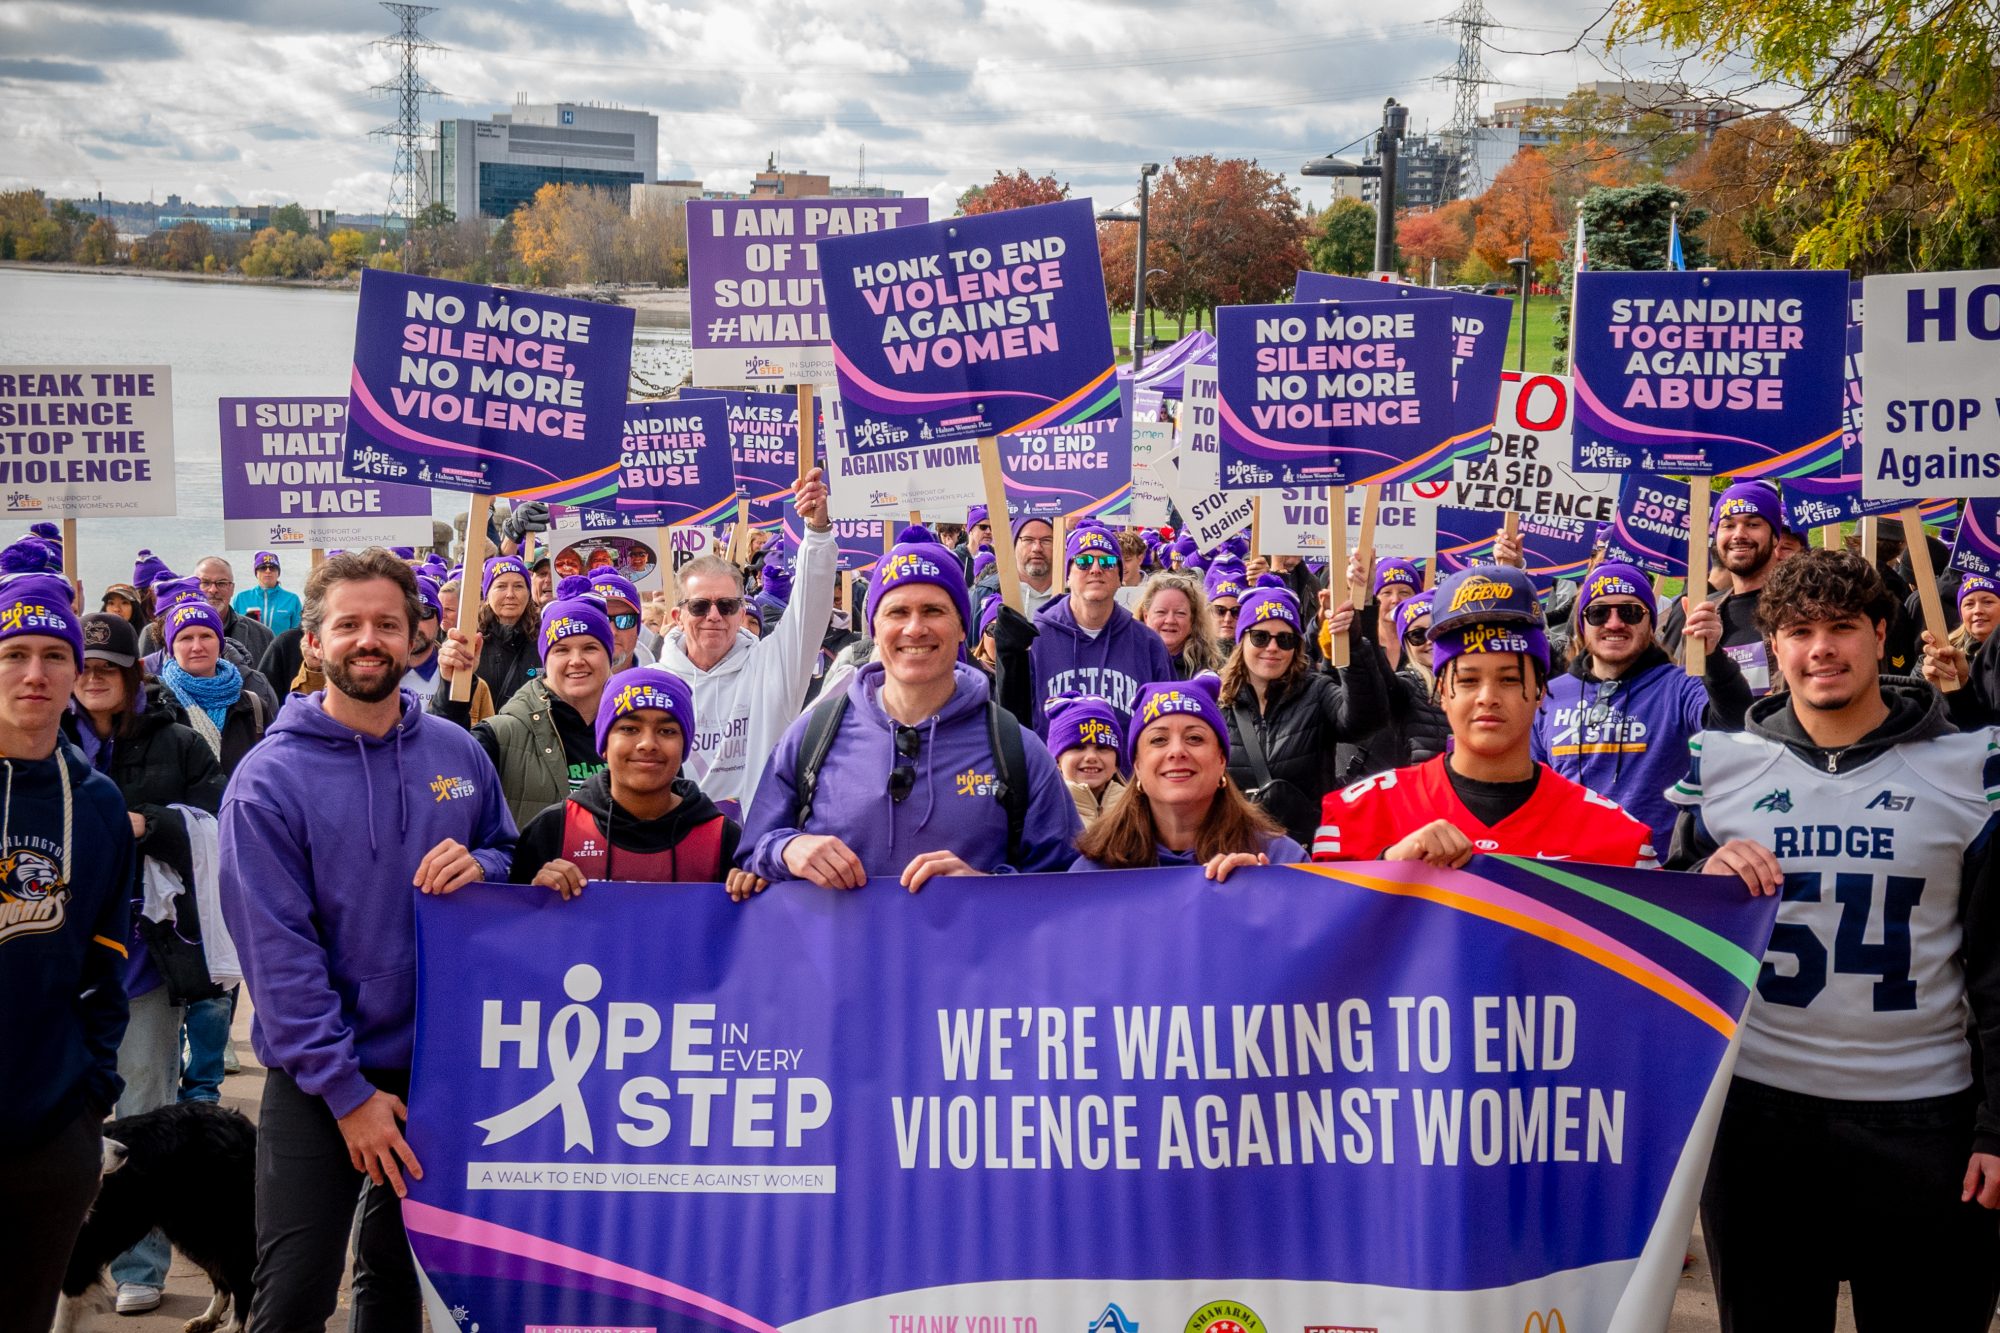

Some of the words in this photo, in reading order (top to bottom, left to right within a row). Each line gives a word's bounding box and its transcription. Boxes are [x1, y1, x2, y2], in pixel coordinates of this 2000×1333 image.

[564, 111, 573, 123] H
[712, 208, 725, 237] I
[733, 208, 795, 237] AM
[804, 206, 903, 236] PART
[745, 243, 792, 272] OF
[853, 254, 943, 289] HONK
[948, 247, 993, 273] TO
[1001, 236, 1067, 266] END
[861, 260, 1064, 316] VIOLENCE
[405, 290, 466, 325] NO
[476, 300, 592, 344] MORE
[881, 292, 1055, 344] AGAINST
[1612, 298, 1803, 324] STANDING
[1256, 317, 1307, 344] NO
[1316, 314, 1415, 342] MORE
[1608, 325, 1804, 350] TOGETHER
[401, 323, 577, 380] SILENCE,
[883, 322, 1060, 375] WOMEN
[1256, 343, 1406, 373] SILENCE,
[759, 366, 784, 375] STEP
[1624, 350, 1787, 376] AGAINST
[0, 374, 84, 397] REAK
[91, 374, 155, 397] THE
[399, 355, 460, 389] NO
[470, 365, 585, 408] MORE
[1257, 375, 1308, 401] NO
[1317, 371, 1416, 399] MORE
[1623, 378, 1784, 410] ABUSE
[0, 402, 133, 426] SILENCE
[235, 404, 247, 427] I
[390, 386, 587, 441] VIOLENCE
[1193, 406, 1215, 426] TO
[1251, 400, 1421, 430] VIOLENCE
[1886, 398, 1981, 434] STOP
[854, 419, 889, 440] HOPE
[875, 431, 909, 447] STEP
[82, 431, 146, 454] THE
[743, 434, 784, 450] END
[1020, 436, 1048, 454] TO
[1053, 434, 1096, 452] END
[1581, 441, 1614, 460] HOPE
[353, 446, 390, 466] HOPE
[841, 448, 920, 477] AGAINST
[1006, 451, 1109, 472] VIOLENCE
[1599, 457, 1632, 468] STEP
[372, 464, 408, 477] STEP
[1227, 460, 1257, 476] HOPE
[1243, 473, 1274, 484] STEP
[1466, 459, 1554, 489] BASED
[20, 500, 42, 508] STEP
[56, 494, 91, 502] SUPPORT
[280, 489, 382, 514] PLACE
[1456, 482, 1614, 521] VIOLENCE
[585, 510, 606, 522] HOPE
[1632, 500, 1673, 525] FOR
[1732, 504, 1759, 514] STEP
[1794, 500, 1824, 519] HOPE
[1812, 507, 1841, 521] STEP
[270, 524, 292, 538] HOPE
[318, 528, 350, 536] SUPPORT
[597, 519, 617, 527] STEP
[283, 533, 304, 541] STEP
[338, 535, 373, 543] WOMEN'S
[374, 534, 396, 542] PLACE
[671, 529, 706, 552] AND
[1091, 539, 1114, 551] STEP
[882, 555, 918, 580] HOPE
[1958, 551, 1981, 566] HOPE
[1968, 562, 1991, 573] STEP
[901, 564, 941, 578] STEP
[1590, 575, 1620, 594] HOPE
[1606, 583, 1636, 595] STEP
[1448, 583, 1514, 613] LEGEND
[1, 602, 46, 626] HOPE
[27, 615, 68, 630] STEP
[1271, 608, 1294, 621] STEP
[558, 623, 589, 638] STEP
[1463, 624, 1507, 648] HOPE
[1490, 638, 1529, 652] STEP
[613, 685, 652, 711] HOPE
[635, 695, 674, 710] STEP
[1163, 700, 1202, 713] STEP
[1080, 719, 1111, 739] HOPE
[1584, 722, 1647, 743] STEP
[429, 775, 459, 796] HOPE
[956, 769, 993, 788] HOPE
[450, 785, 475, 799] STEP
[1773, 824, 1896, 861] RIDGE
[1755, 872, 1927, 1013] 54
[475, 966, 717, 1086] HOPE
[722, 1023, 750, 1045] IN
[936, 1005, 1099, 1082] WE'RE
[1113, 997, 1374, 1082] WALKING
[1387, 994, 1451, 1074] TO
[1472, 993, 1577, 1073] END
[719, 1048, 804, 1072] EVERY
[616, 1076, 833, 1148] STEP
[890, 1094, 1141, 1171] VIOLENCE
[1157, 1086, 1399, 1171] AGAINST
[1411, 1085, 1627, 1168] WOMEN
[481, 1171, 494, 1184] A
[497, 1170, 543, 1184] WALK
[546, 1171, 569, 1184] TO
[572, 1171, 608, 1185] END
[611, 1172, 690, 1187] VIOLENCE
[694, 1172, 760, 1187] AGAINST
[763, 1174, 825, 1187] WOMEN
[889, 1315, 960, 1333] THANK
[964, 1316, 1007, 1333] YOU
[1012, 1317, 1038, 1333] TO
[1192, 1304, 1256, 1331] SHAWARMA
